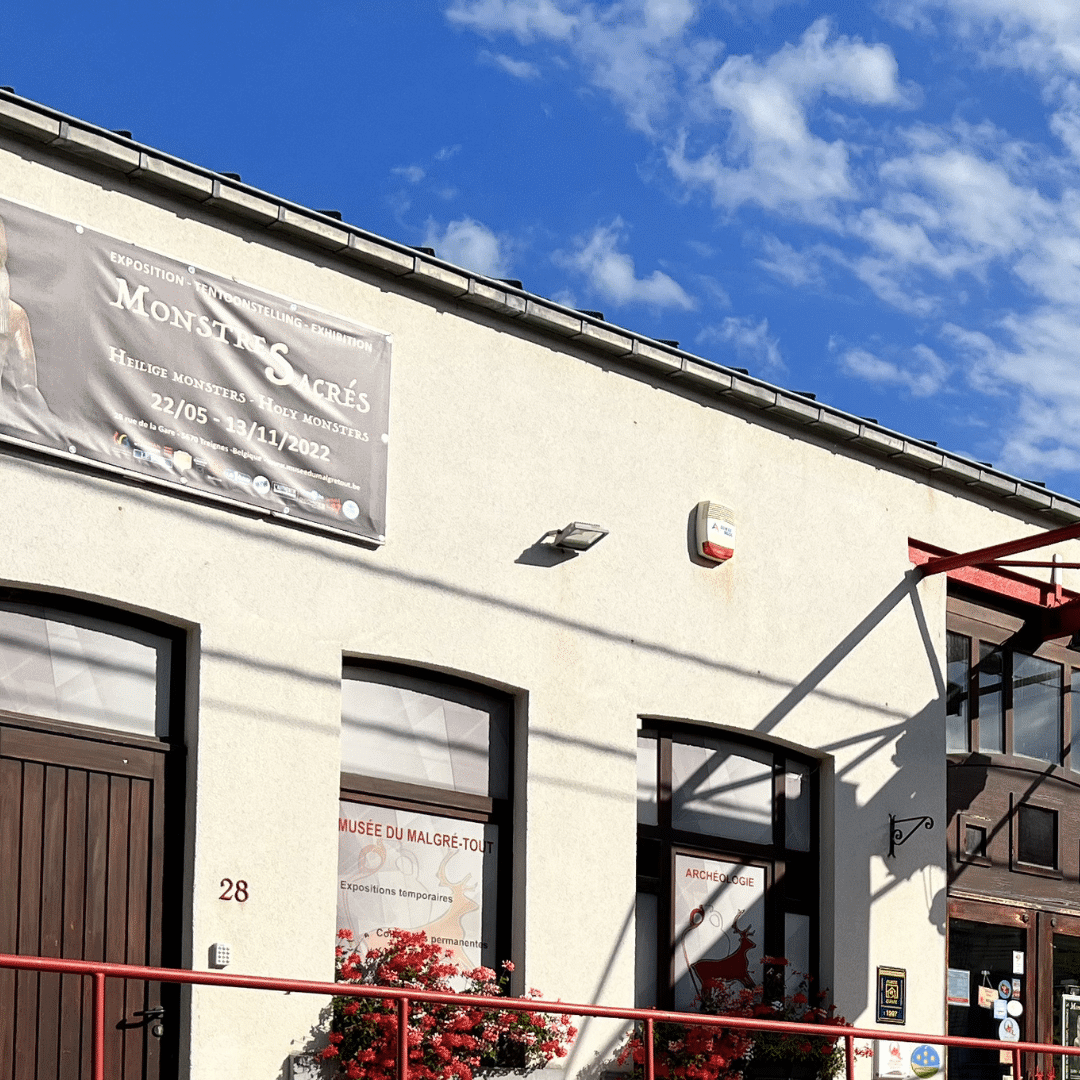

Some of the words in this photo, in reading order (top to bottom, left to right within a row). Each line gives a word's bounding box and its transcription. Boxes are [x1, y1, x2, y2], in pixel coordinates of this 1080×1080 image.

[110, 251, 184, 286] EXPOSITION
[193, 279, 303, 328] TENTOONSTELLING
[311, 323, 373, 353] EXHIBITION
[109, 346, 168, 379] HEILIGE
[171, 371, 246, 404] MONSTERS
[257, 394, 299, 420] HOLY
[302, 413, 369, 442] MONSTERS
[138, 419, 149, 429] de
[149, 422, 157, 431] la
[157, 425, 176, 437] Gare
[151, 392, 208, 425] 22/05
[225, 416, 330, 462] 13/11/2022
[338, 818, 383, 838] MUSÉE
[386, 825, 404, 841] DU
[406, 829, 494, 854] MALGRÉ-TOUT
[218, 877, 250, 903] 28
[685, 868, 755, 887] ARCHÉOLOGIE
[340, 880, 397, 897] Expositions
[398, 888, 454, 904] temporaires
[431, 936, 489, 949] permanentes
